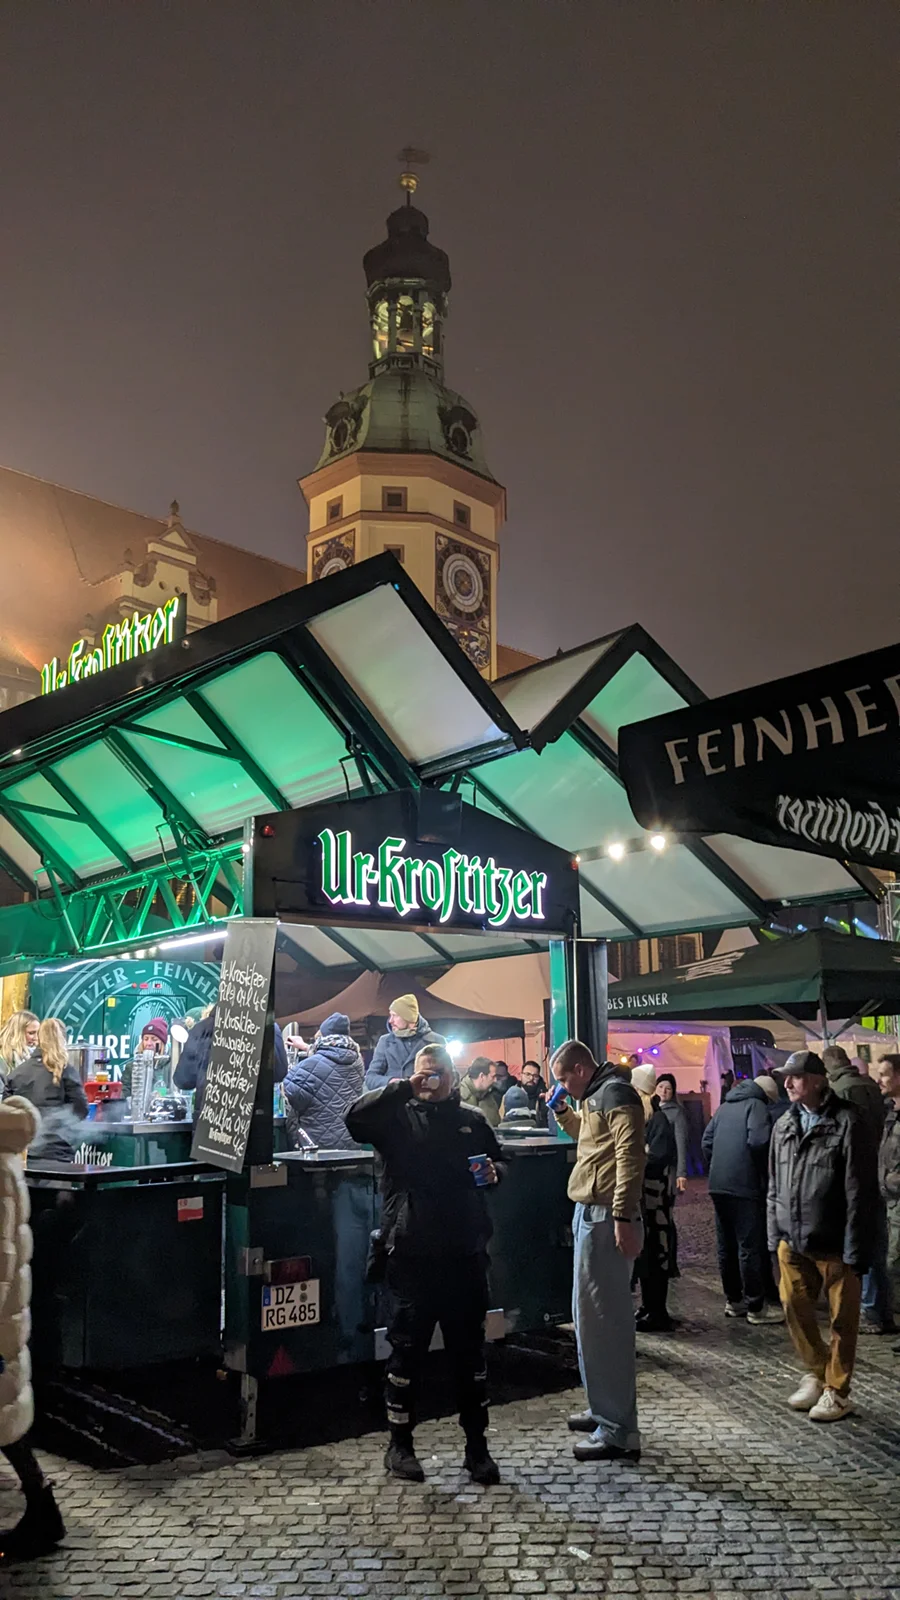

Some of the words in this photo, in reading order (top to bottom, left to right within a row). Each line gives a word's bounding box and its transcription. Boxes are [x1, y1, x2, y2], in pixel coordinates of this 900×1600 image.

[627, 992, 669, 1008] PILSNER
[275, 1286, 295, 1305] DZ
[266, 1307, 286, 1327] RG
[289, 1303, 316, 1323] 485
